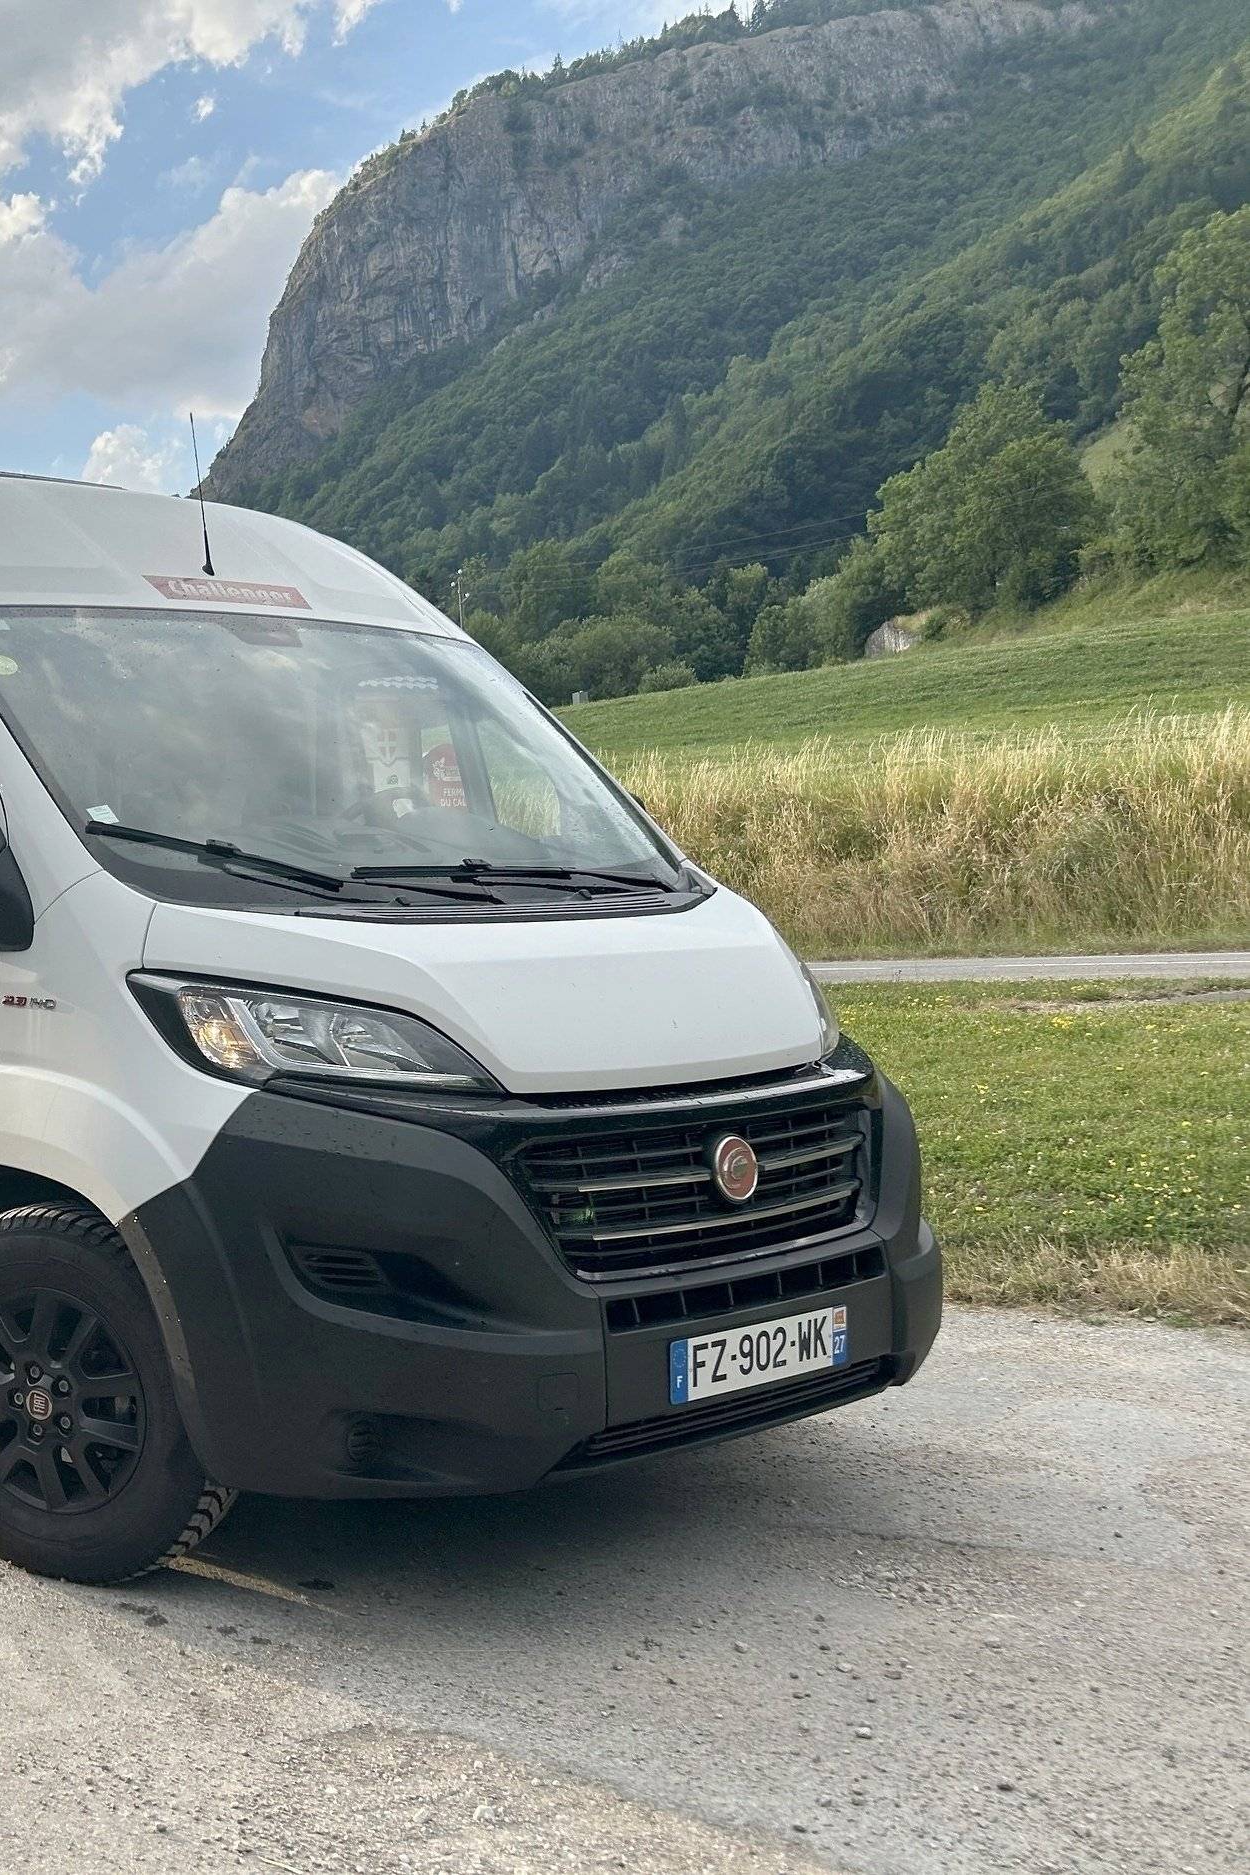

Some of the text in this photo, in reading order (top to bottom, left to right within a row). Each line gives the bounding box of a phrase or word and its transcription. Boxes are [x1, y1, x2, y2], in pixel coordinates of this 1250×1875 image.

[168, 579, 291, 606] Challenger
[676, 1316, 845, 1388] F FZ-902-WK 27
[33, 1393, 45, 1413] FIAT
